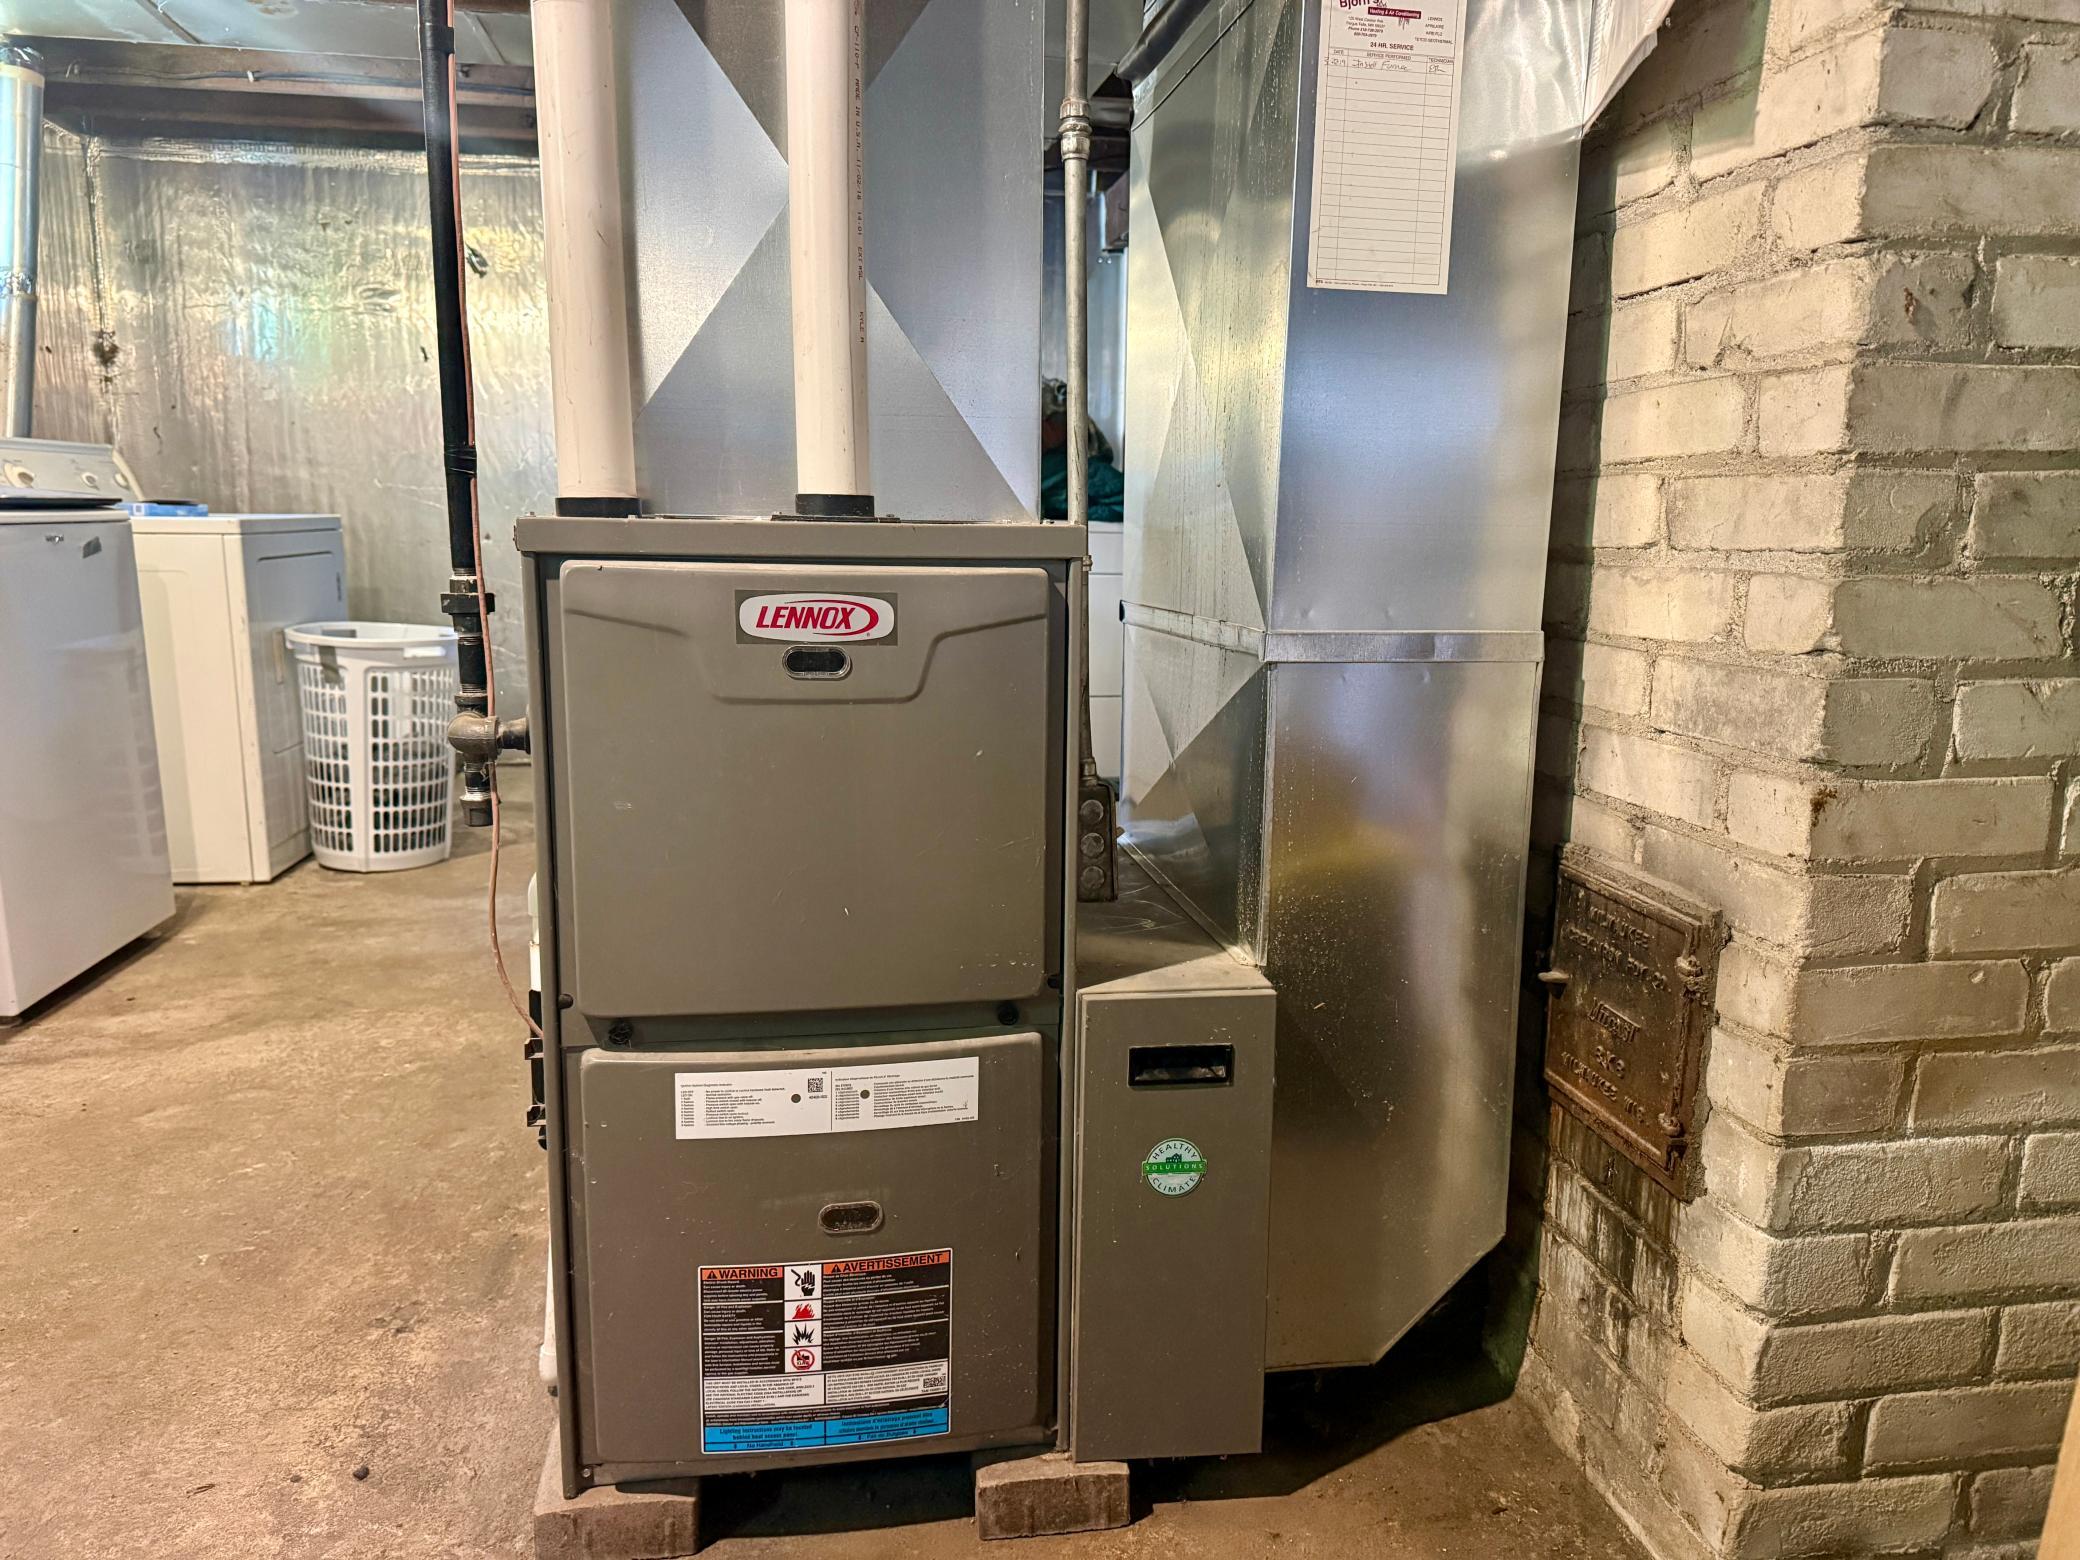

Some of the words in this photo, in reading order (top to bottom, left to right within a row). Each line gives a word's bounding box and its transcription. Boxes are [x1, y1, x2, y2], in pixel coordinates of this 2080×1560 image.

[756, 606, 856, 630] LENNOX
[1152, 1142, 1197, 1160] HEALTHY
[1153, 1176, 1196, 1192] CLIMATE
[843, 1254, 942, 1272] AVERTISSEMENT
[719, 1268, 778, 1279] WARNING
